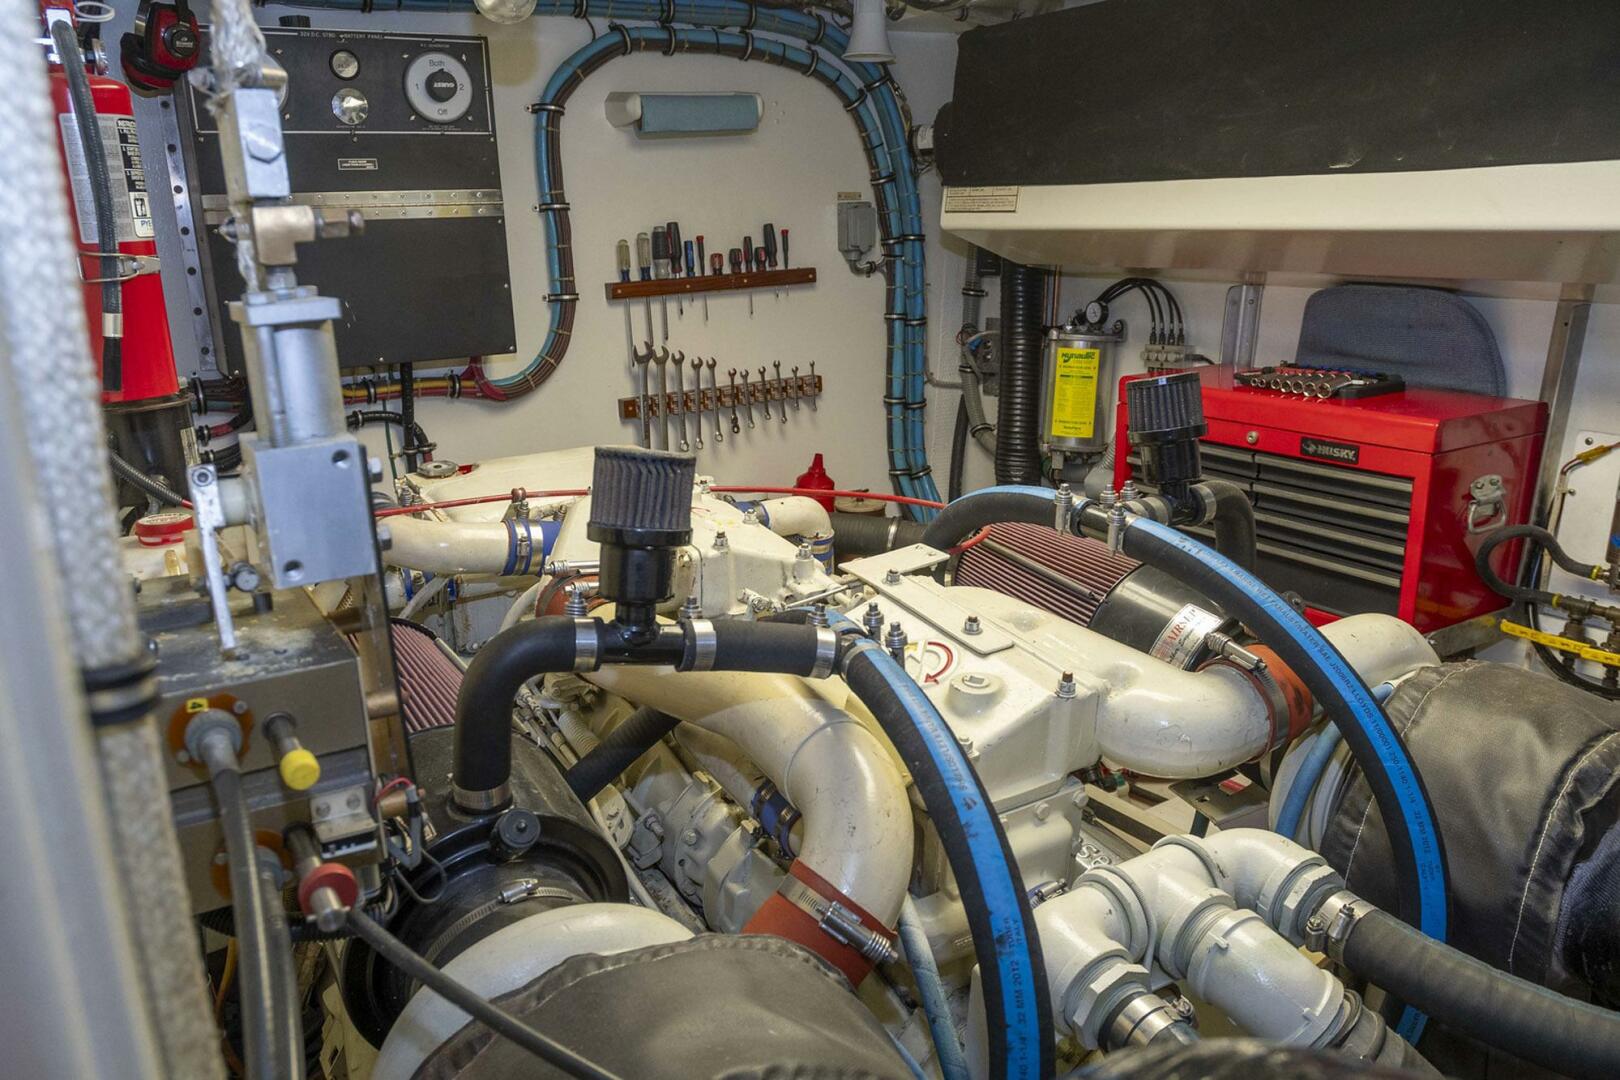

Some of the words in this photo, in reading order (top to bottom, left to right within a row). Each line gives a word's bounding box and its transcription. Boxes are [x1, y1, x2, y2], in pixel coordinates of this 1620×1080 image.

[429, 59, 446, 67] Both
[459, 83, 465, 91] 2
[437, 108, 448, 116] Off
[1317, 445, 1356, 462] HUSKY
[1013, 989, 1024, 1008] MM
